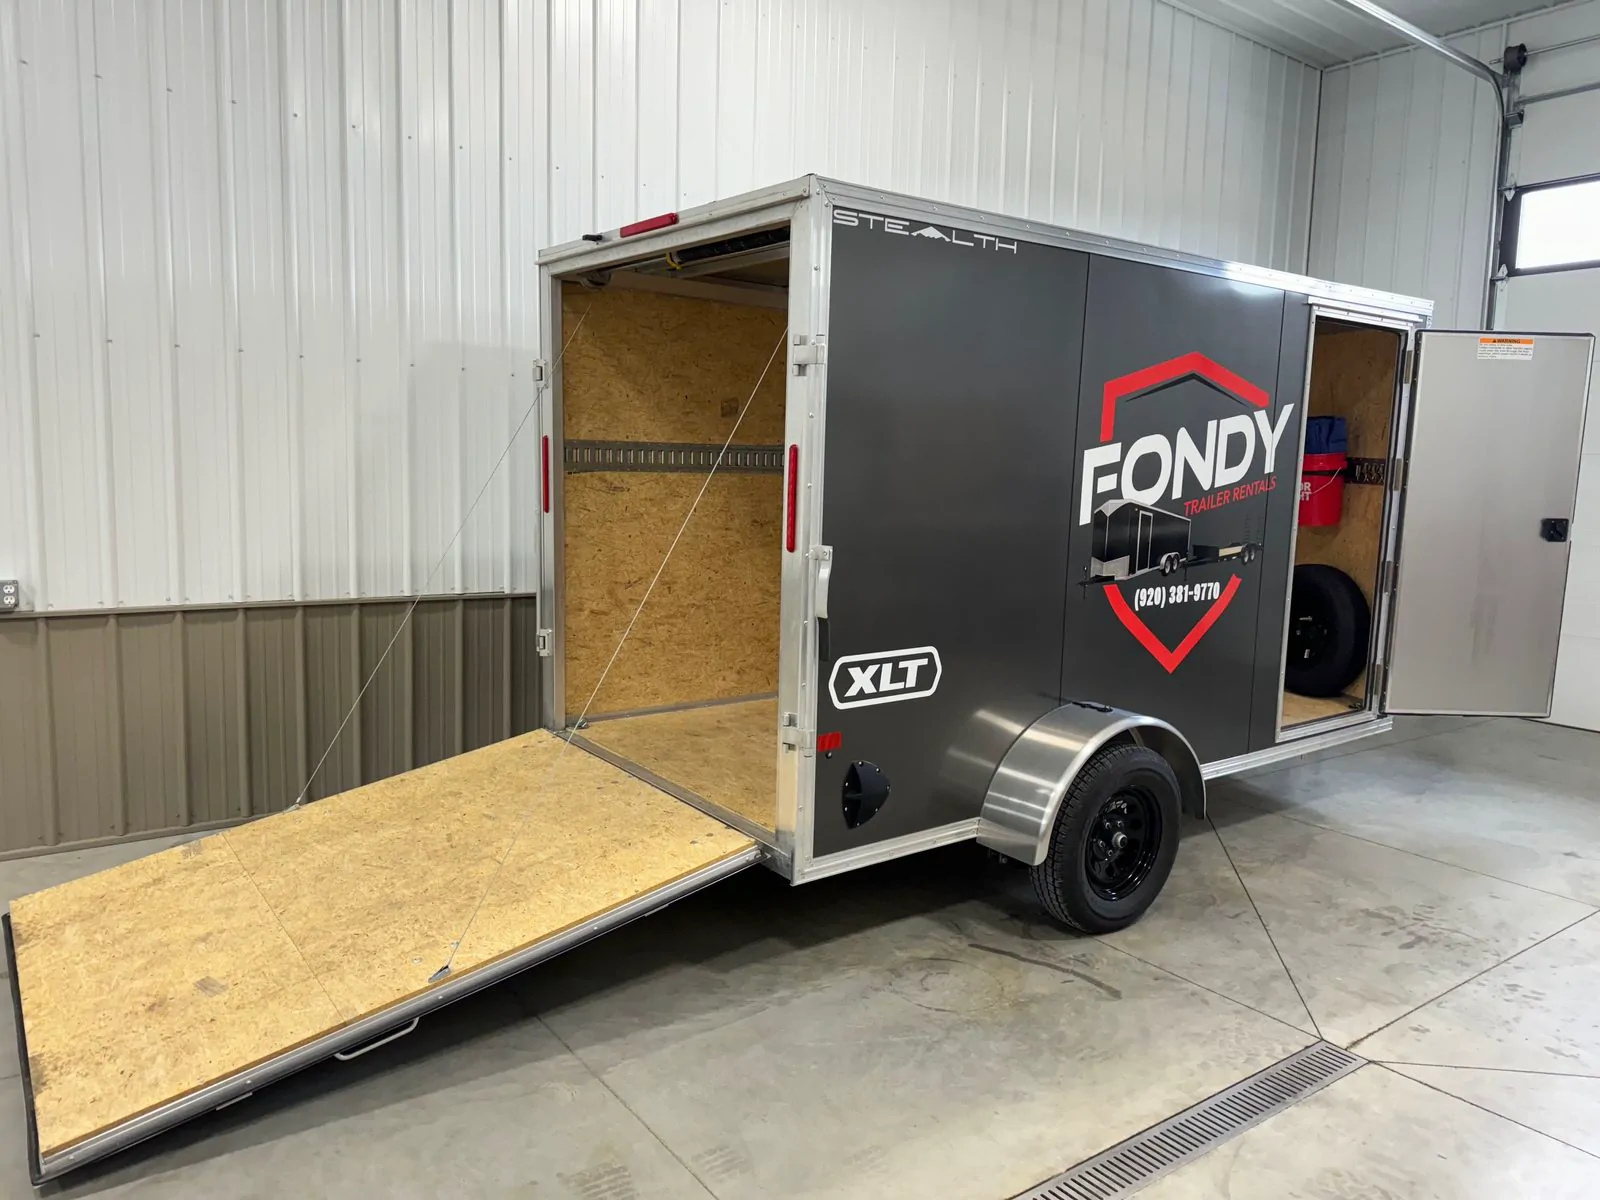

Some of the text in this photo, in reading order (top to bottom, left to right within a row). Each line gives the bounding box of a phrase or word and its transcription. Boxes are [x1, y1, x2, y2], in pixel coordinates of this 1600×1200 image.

[833, 209, 1017, 254] STEALTH
[1079, 403, 1295, 526] FONDY
[1184, 475, 1277, 516] TRAILER RENTALS
[1134, 581, 1220, 611] (920) 381-9770
[844, 658, 929, 697] XLT
